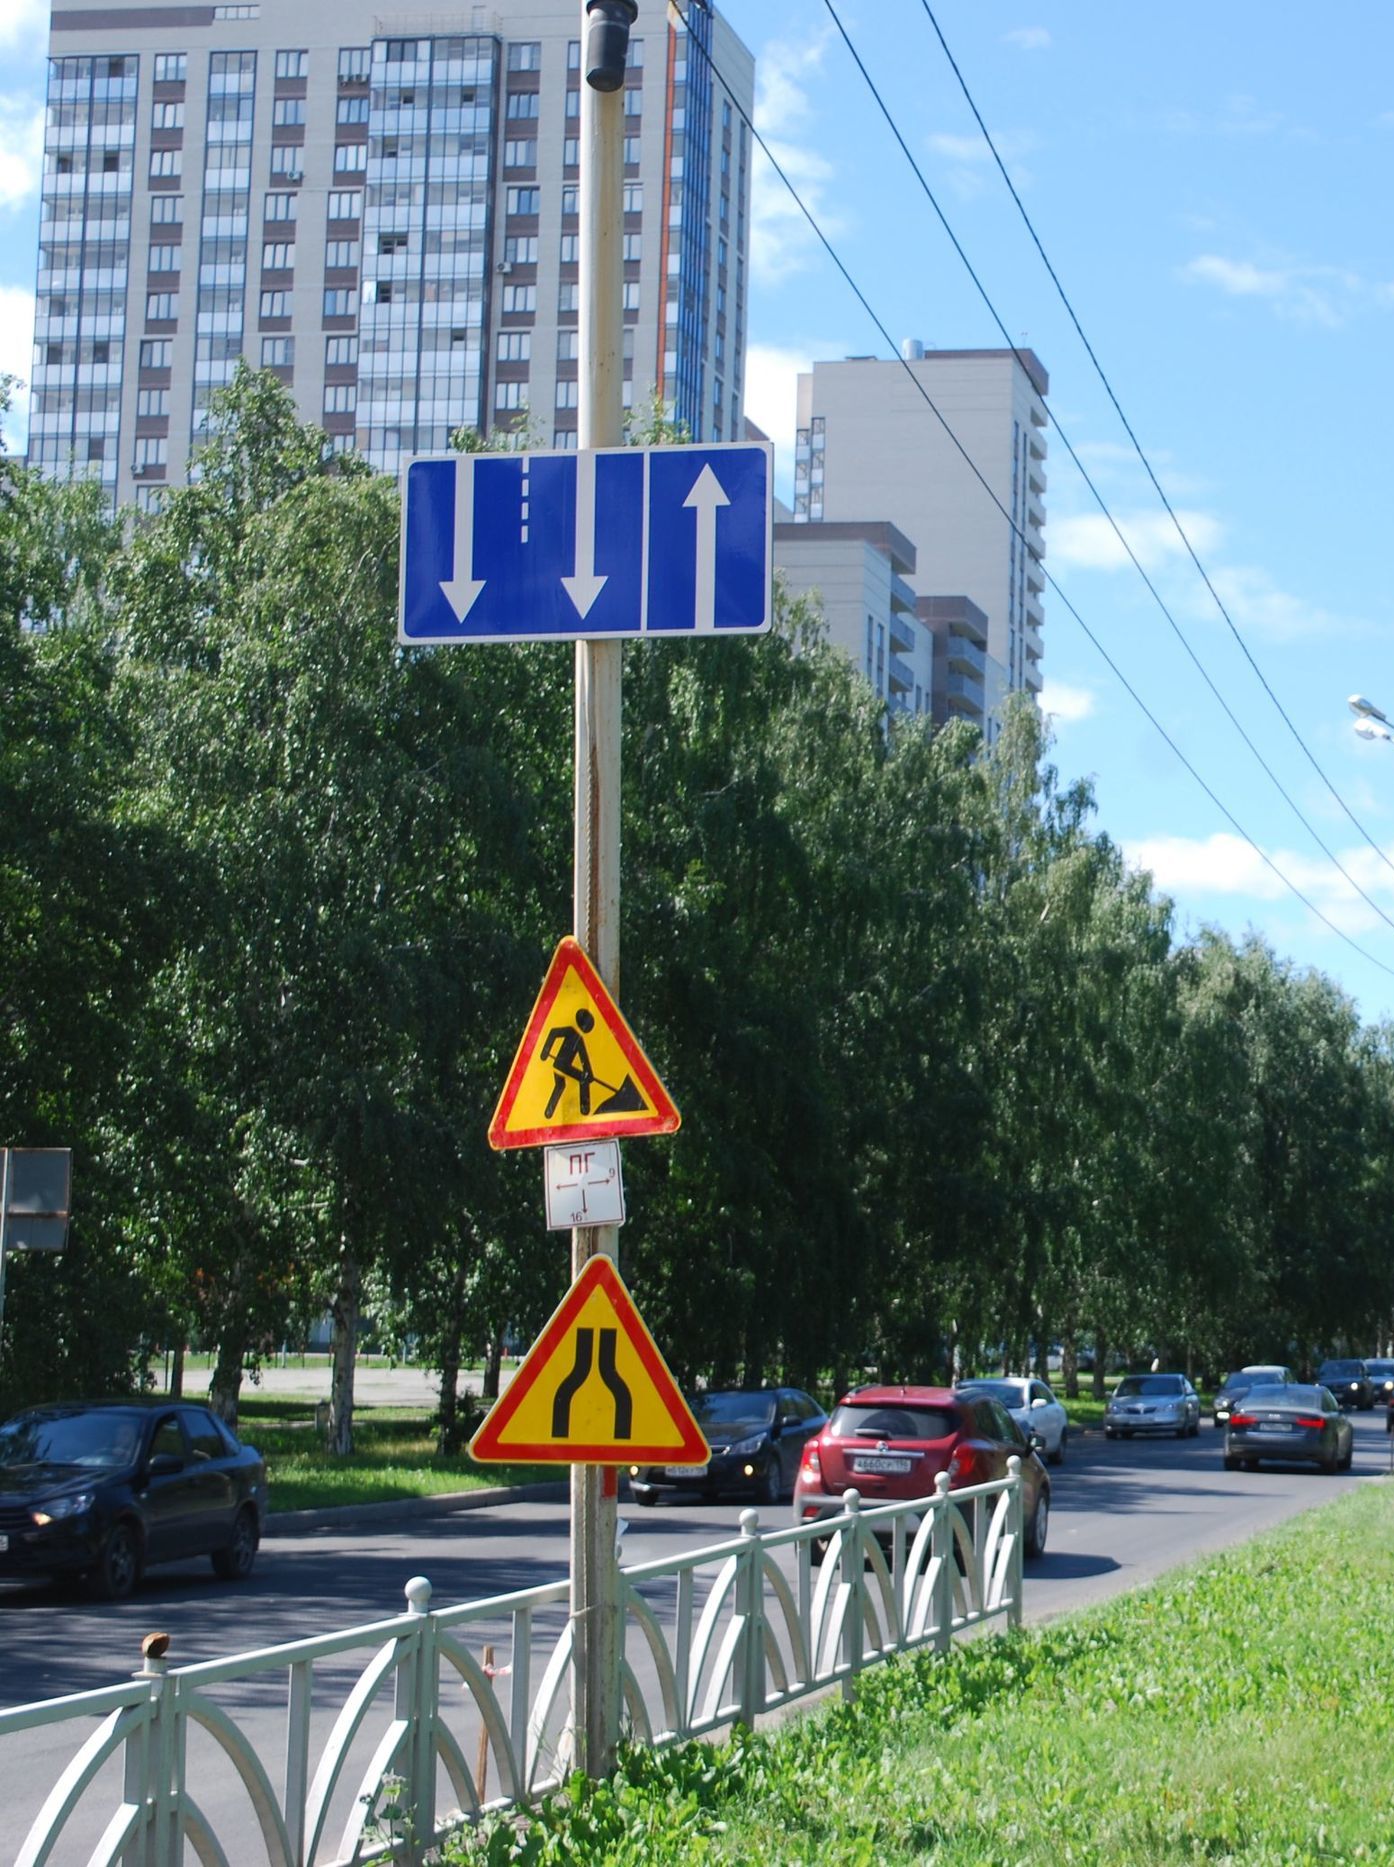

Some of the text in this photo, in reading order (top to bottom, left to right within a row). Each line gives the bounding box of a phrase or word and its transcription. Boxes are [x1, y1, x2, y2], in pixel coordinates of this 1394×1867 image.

[569, 1151, 596, 1175] ПГ
[608, 1167, 616, 1178] 9
[570, 1211, 583, 1222] 16
